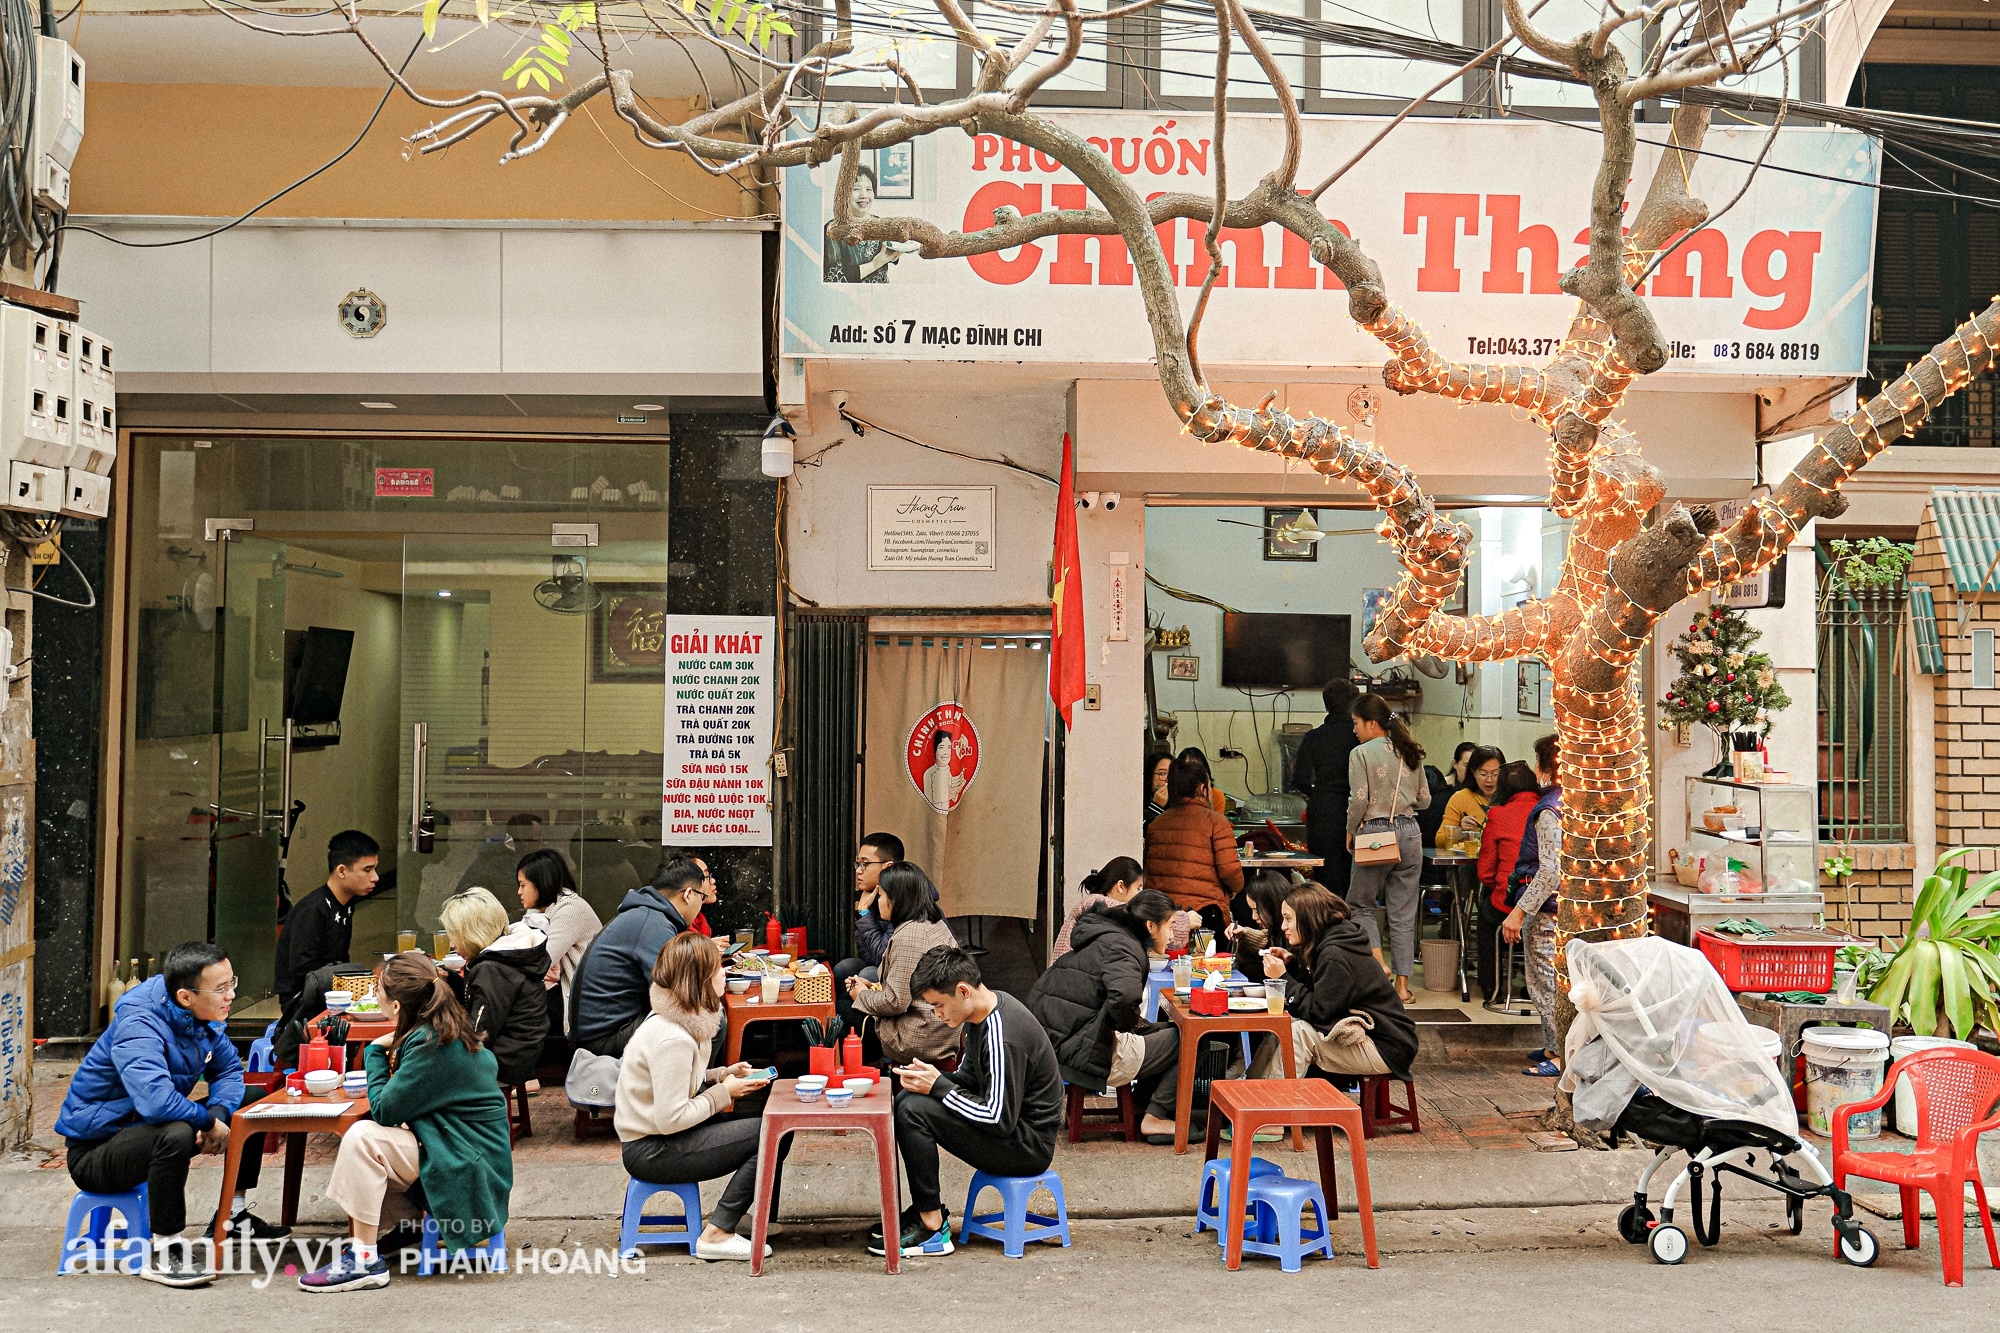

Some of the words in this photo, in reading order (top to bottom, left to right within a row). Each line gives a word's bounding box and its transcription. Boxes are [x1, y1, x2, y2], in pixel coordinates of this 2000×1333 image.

[1403, 178, 1821, 330] Thng
[830, 325, 867, 343] Add:
[873, 320, 897, 344] SỐ
[902, 320, 916, 344] 7
[922, 326, 961, 348] MẠC
[966, 324, 1008, 345] ĐĨNH
[1013, 328, 1042, 346] CHI
[1745, 342, 1775, 360] 684
[1780, 343, 1820, 361] 8819
[626, 607, 665, 652] 福
[671, 628, 708, 654] GIẢI
[714, 630, 763, 655] KHÁT
[678, 659, 707, 670] NƯỚC
[709, 661, 733, 670] CAM
[735, 661, 754, 670] 30K
[672, 674, 700, 685] NƯỚC
[703, 675, 738, 685] CHANH
[741, 675, 760, 685] 20K
[676, 689, 705, 700] NƯỚC
[707, 687, 734, 701] QUẤT
[736, 690, 756, 700] 20K
[676, 704, 696, 715] TRÀ
[698, 705, 734, 715] CHANH
[736, 705, 756, 715] 20K
[680, 718, 700, 729] TRÀ
[702, 717, 729, 731] QUẤT
[731, 720, 751, 730] 20K
[676, 733, 696, 744] TRÀ
[698, 733, 733, 744] ĐƯỜNG
[736, 735, 755, 744] 10K
[689, 748, 709, 759] TRÀ
[711, 748, 725, 759] ĐÁ
[728, 750, 741, 759] 5K
[681, 763, 702, 774] SỮA
[705, 763, 727, 774] NGÔ
[729, 765, 749, 774] 15K
[666, 778, 687, 789] SỮA
[689, 778, 710, 791] ĐẬU
[713, 778, 742, 789] NÀNH
[744, 780, 764, 789] 10K
[663, 793, 691, 803] NƯỚC
[694, 793, 715, 804] NGÔ
[718, 793, 744, 806] LUỘC
[747, 795, 766, 804] 10K
[673, 809, 695, 819] BIA,
[697, 808, 725, 819] NƯỚC
[728, 809, 755, 821] NGỌT
[671, 824, 699, 834] LAIVE
[701, 822, 723, 834] CÁC
